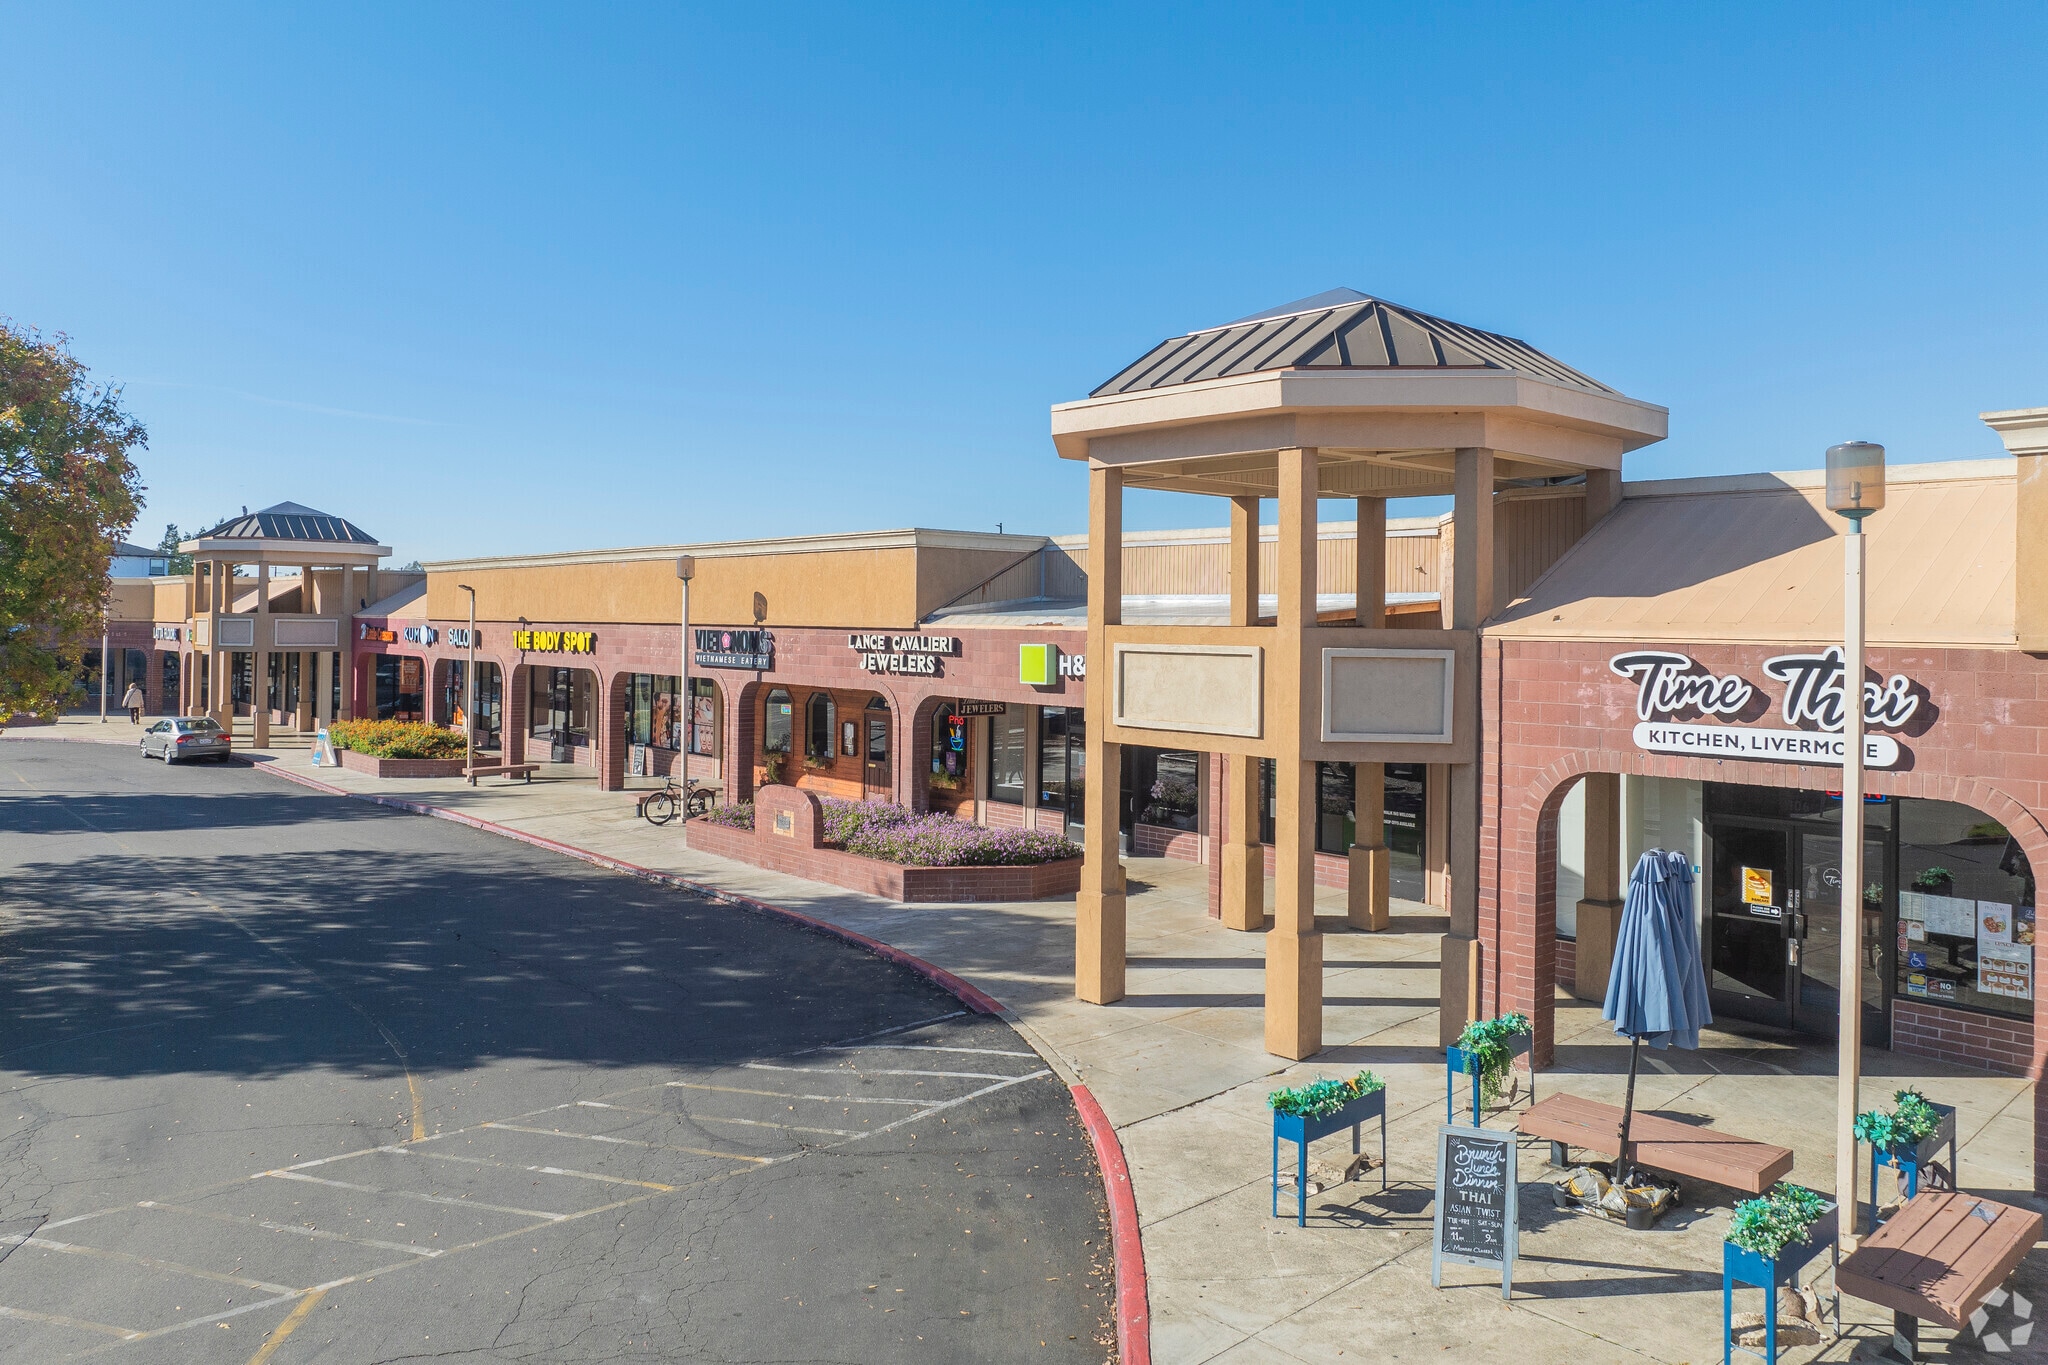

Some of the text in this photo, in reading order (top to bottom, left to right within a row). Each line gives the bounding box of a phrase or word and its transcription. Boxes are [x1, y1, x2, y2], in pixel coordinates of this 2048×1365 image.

[404, 625, 434, 645] KUMON
[449, 628, 471, 646] SALO
[513, 631, 592, 652] THE BODY SPOT
[848, 634, 952, 652] LANCE CAVALIERI
[696, 654, 766, 666] VIETNAMESE EATERY
[860, 653, 935, 673] JEWELERS
[1059, 655, 1085, 676] H&
[1612, 653, 1750, 719] Time
[961, 704, 1004, 714] JEWELERS
[1649, 730, 1878, 758] KITCHEN, LIVERMOE
[1940, 982, 1952, 990] NO
[1464, 1159, 1501, 1177] Lunch
[1452, 1168, 1498, 1189] Dinner
[1459, 1190, 1492, 1205] THAI
[1450, 1204, 1501, 1218] ASIAN TWIST
